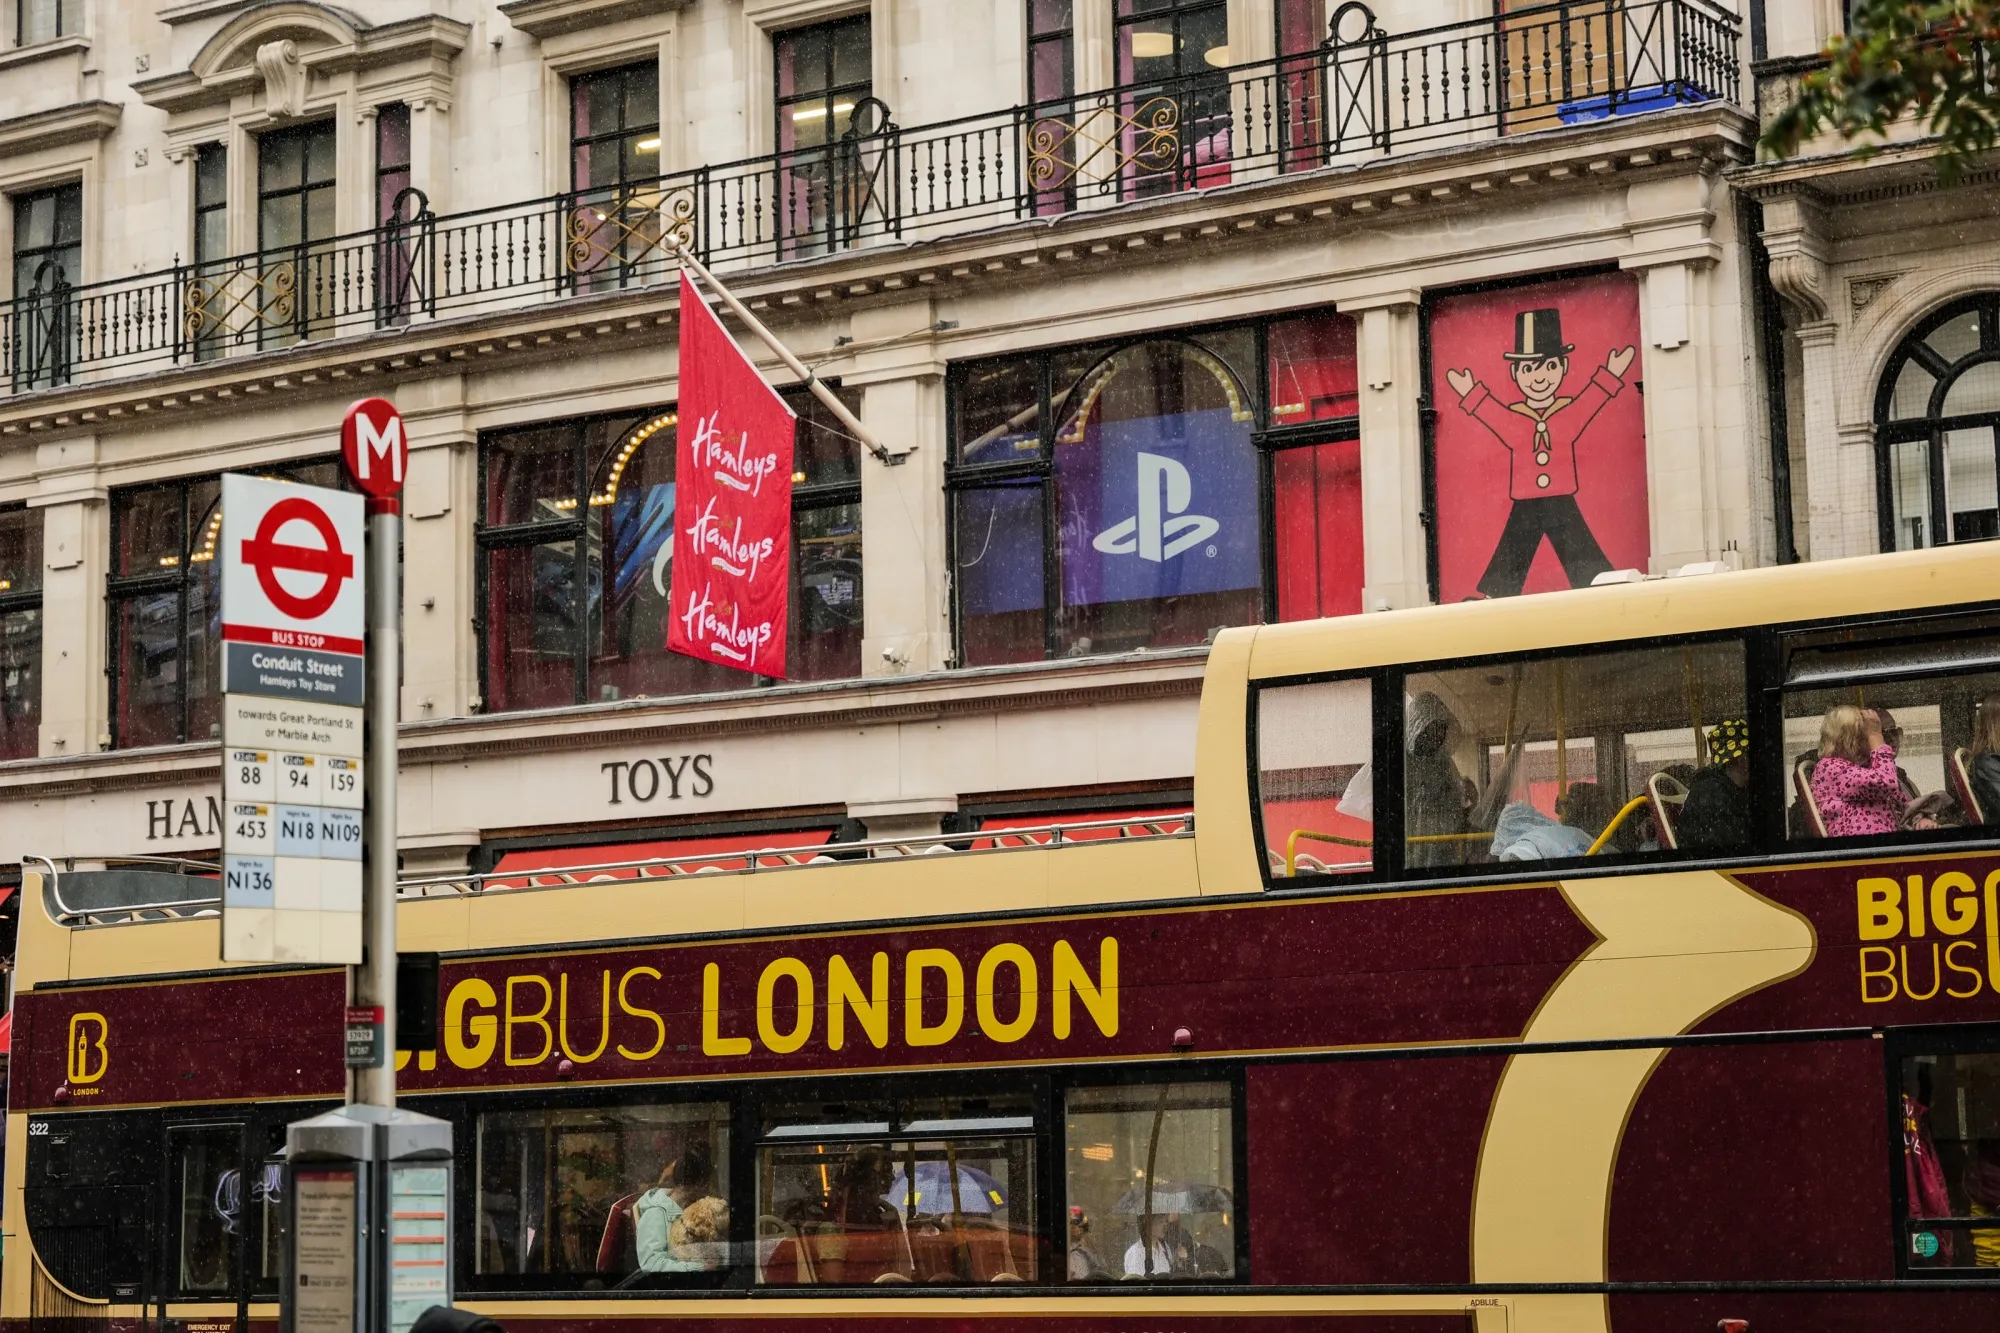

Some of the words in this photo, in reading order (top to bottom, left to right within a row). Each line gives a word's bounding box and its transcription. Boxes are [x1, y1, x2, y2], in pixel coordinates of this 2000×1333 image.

[355, 412, 402, 483] M
[691, 409, 777, 497] Hamleys
[686, 495, 774, 582] Hamleys
[681, 581, 771, 667] Hamleys
[271, 631, 294, 645] BUS
[297, 634, 325, 648] STOP
[251, 652, 304, 674] Conduit
[306, 657, 344, 678] Street
[260, 674, 296, 690] Hamleys
[299, 678, 313, 692] Toy
[314, 679, 336, 693] Store
[238, 709, 277, 722] towards
[280, 712, 305, 725] Great
[307, 714, 343, 729] Portland
[345, 719, 354, 730] St
[265, 728, 275, 737] or
[278, 728, 308, 741] Marble
[311, 731, 331, 743] Arch
[241, 766, 261, 784] 88
[289, 769, 309, 788] 94
[331, 773, 355, 791] 159
[601, 754, 714, 804] TOYS
[236, 820, 266, 839] 453
[282, 820, 315, 840] N18
[322, 822, 360, 842] N109
[227, 871, 272, 891] N136
[1856, 871, 1979, 941] BIG
[1859, 940, 1983, 1003] BUS
[702, 935, 1119, 1057] LONDON
[73, 1087, 99, 1096] LONDON
[29, 1122, 49, 1136] 322
[1470, 1298, 1499, 1306] ADBLUE
[187, 1323, 219, 1331] EMERGENCY
[219, 1323, 231, 1331] EXIT
